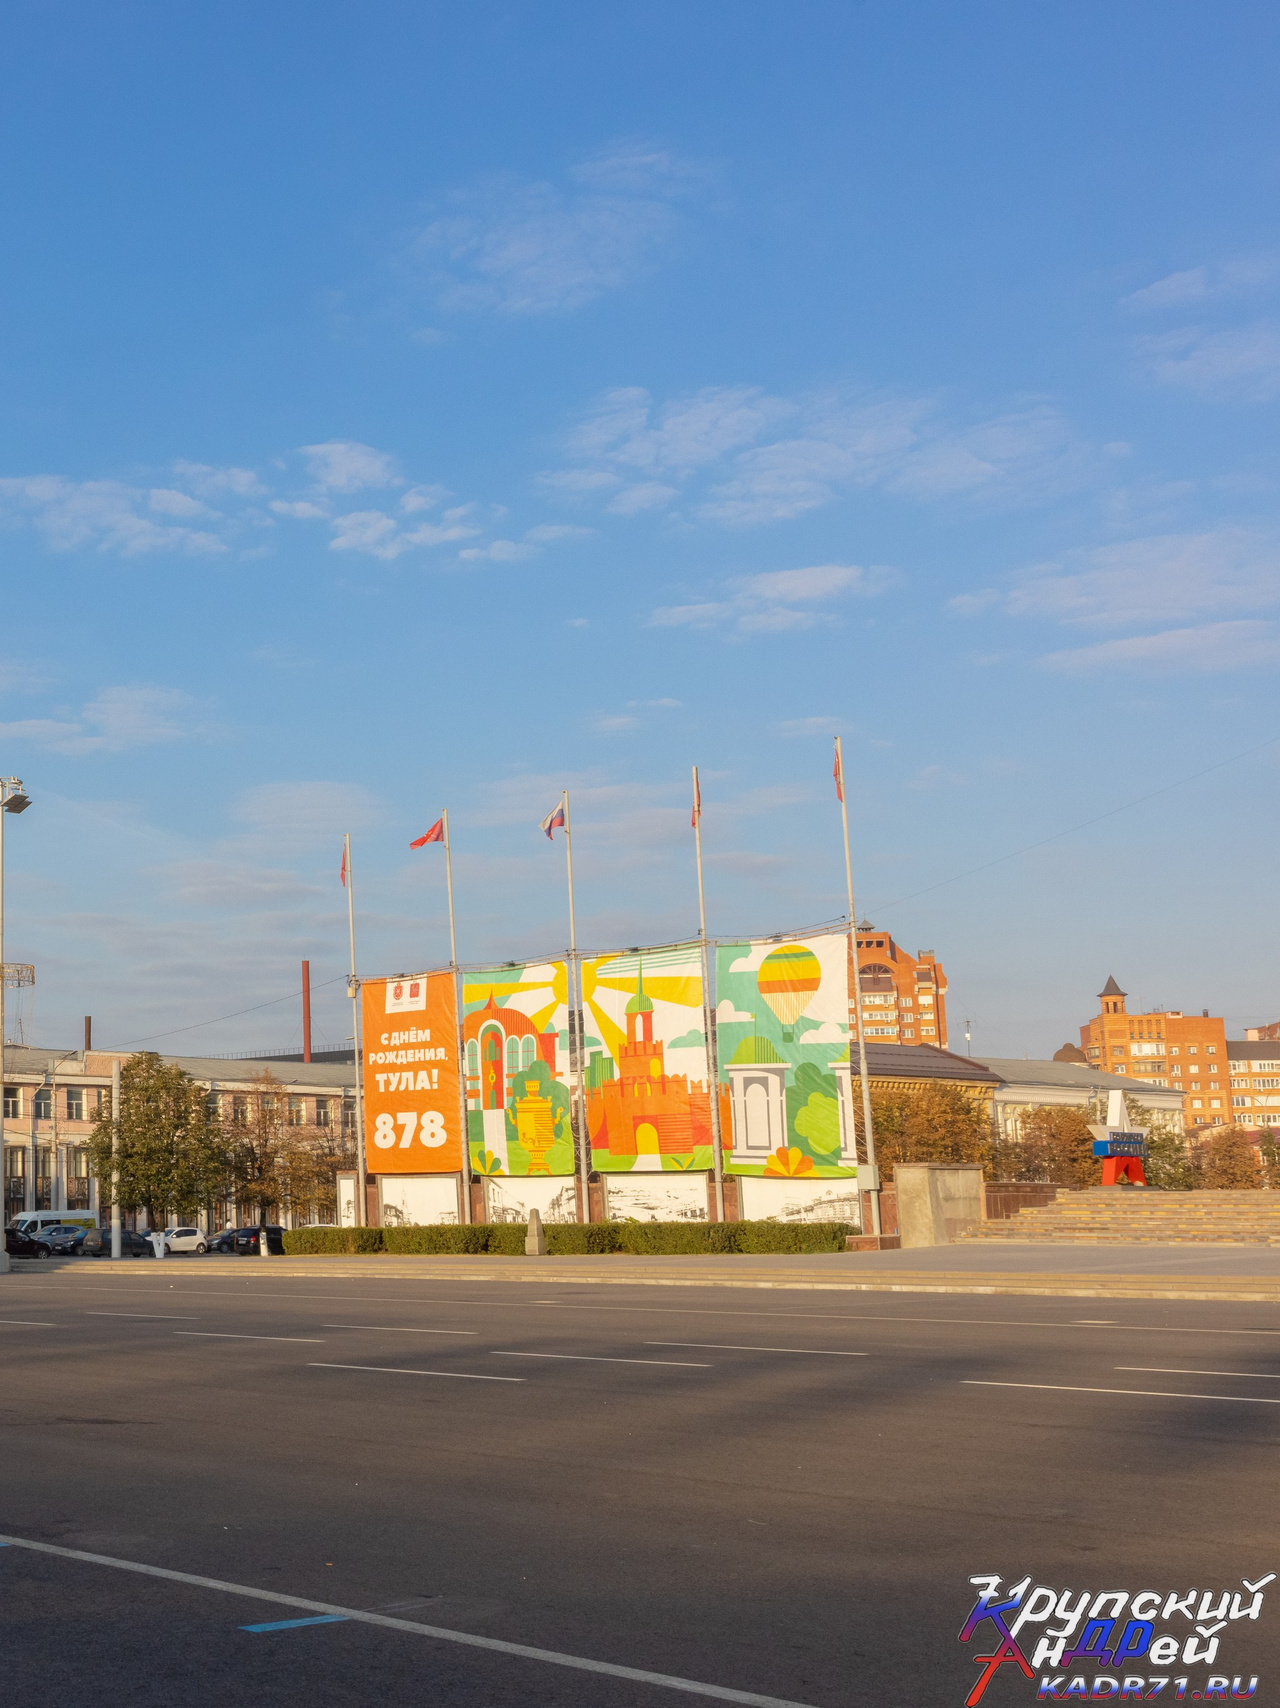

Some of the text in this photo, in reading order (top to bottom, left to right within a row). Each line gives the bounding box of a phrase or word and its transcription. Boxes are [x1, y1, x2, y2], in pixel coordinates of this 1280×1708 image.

[380, 1027, 431, 1046] С ДНЁМ
[368, 1047, 449, 1065] РОЖДЕНИЯ,
[375, 1069, 439, 1092] ТУЛА!
[373, 1110, 448, 1149] 878
